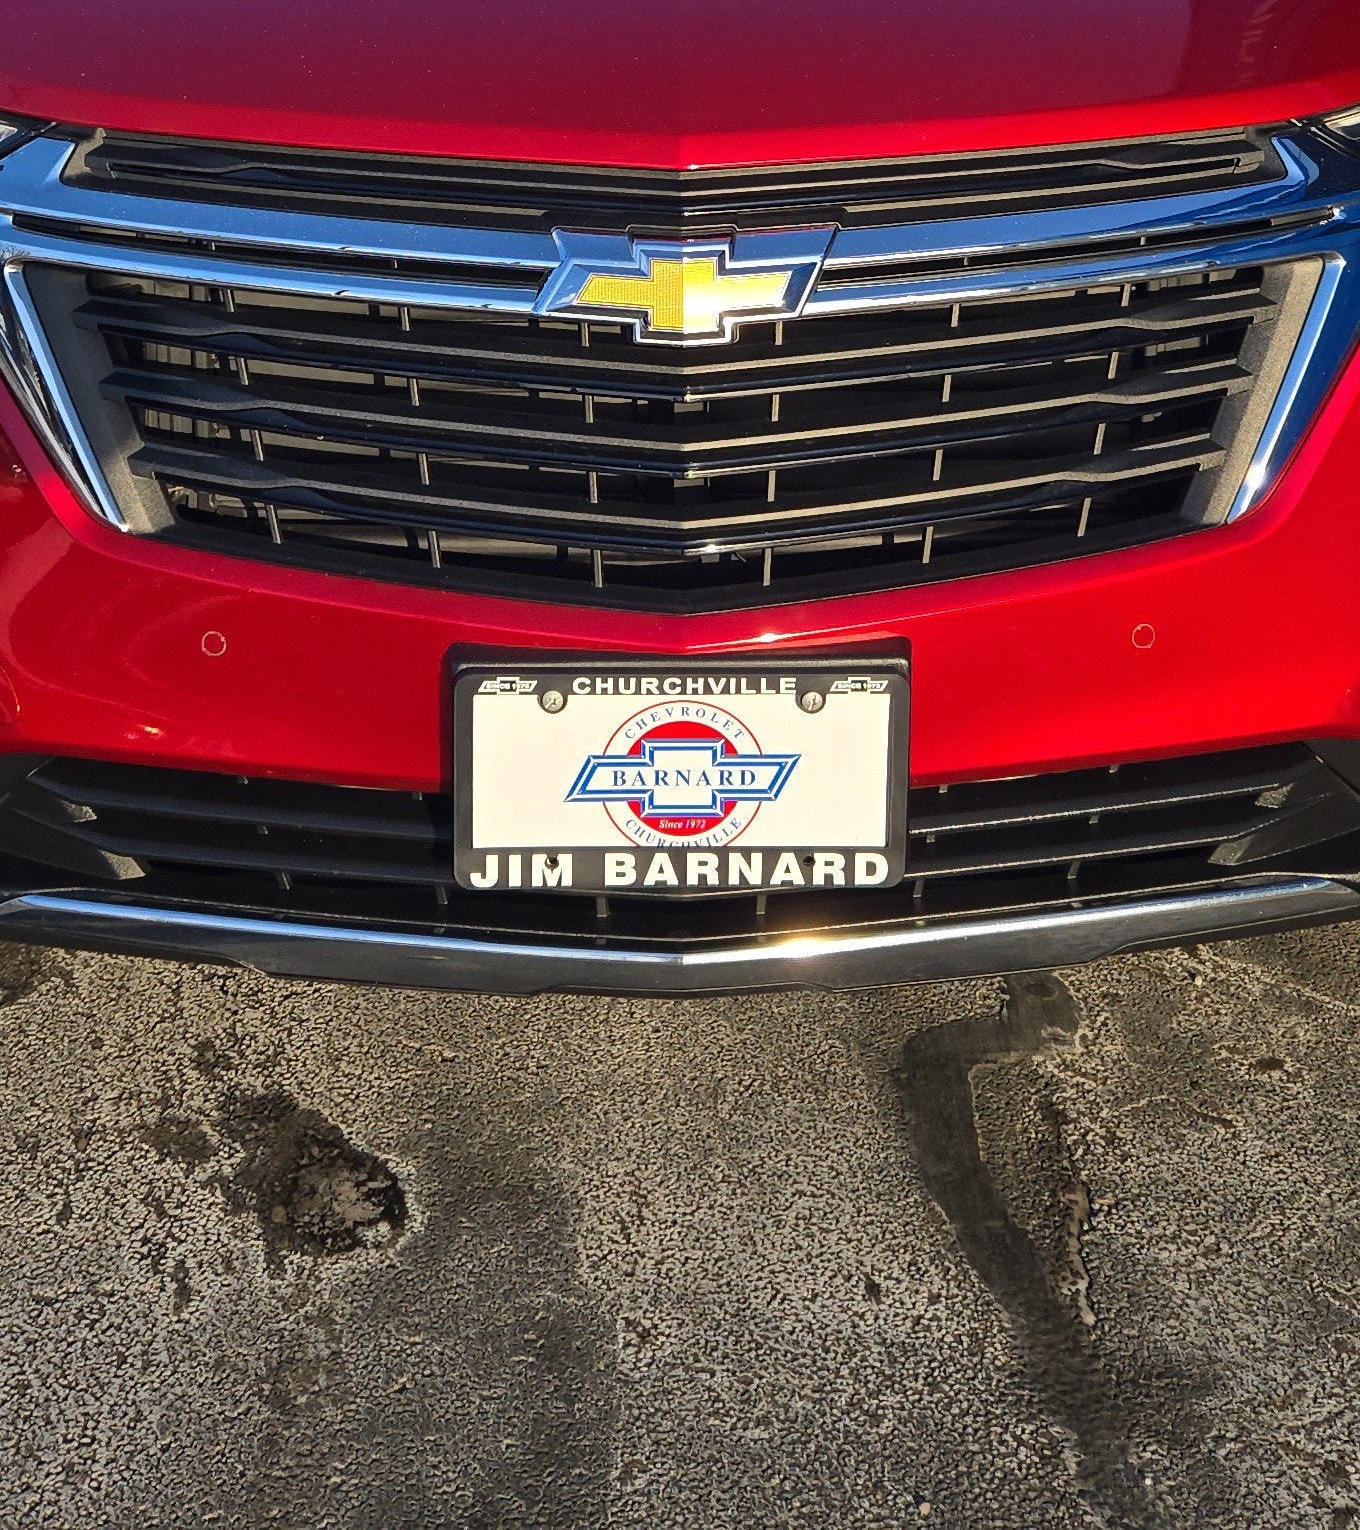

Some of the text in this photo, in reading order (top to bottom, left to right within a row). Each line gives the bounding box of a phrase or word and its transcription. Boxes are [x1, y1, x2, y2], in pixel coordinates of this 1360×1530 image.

[572, 676, 797, 695] CHURCHVILLE
[624, 706, 744, 740] CHEVROLET
[611, 769, 756, 787] BARNARD
[658, 819, 683, 829] Since
[469, 852, 889, 888] JIM BARNARD
